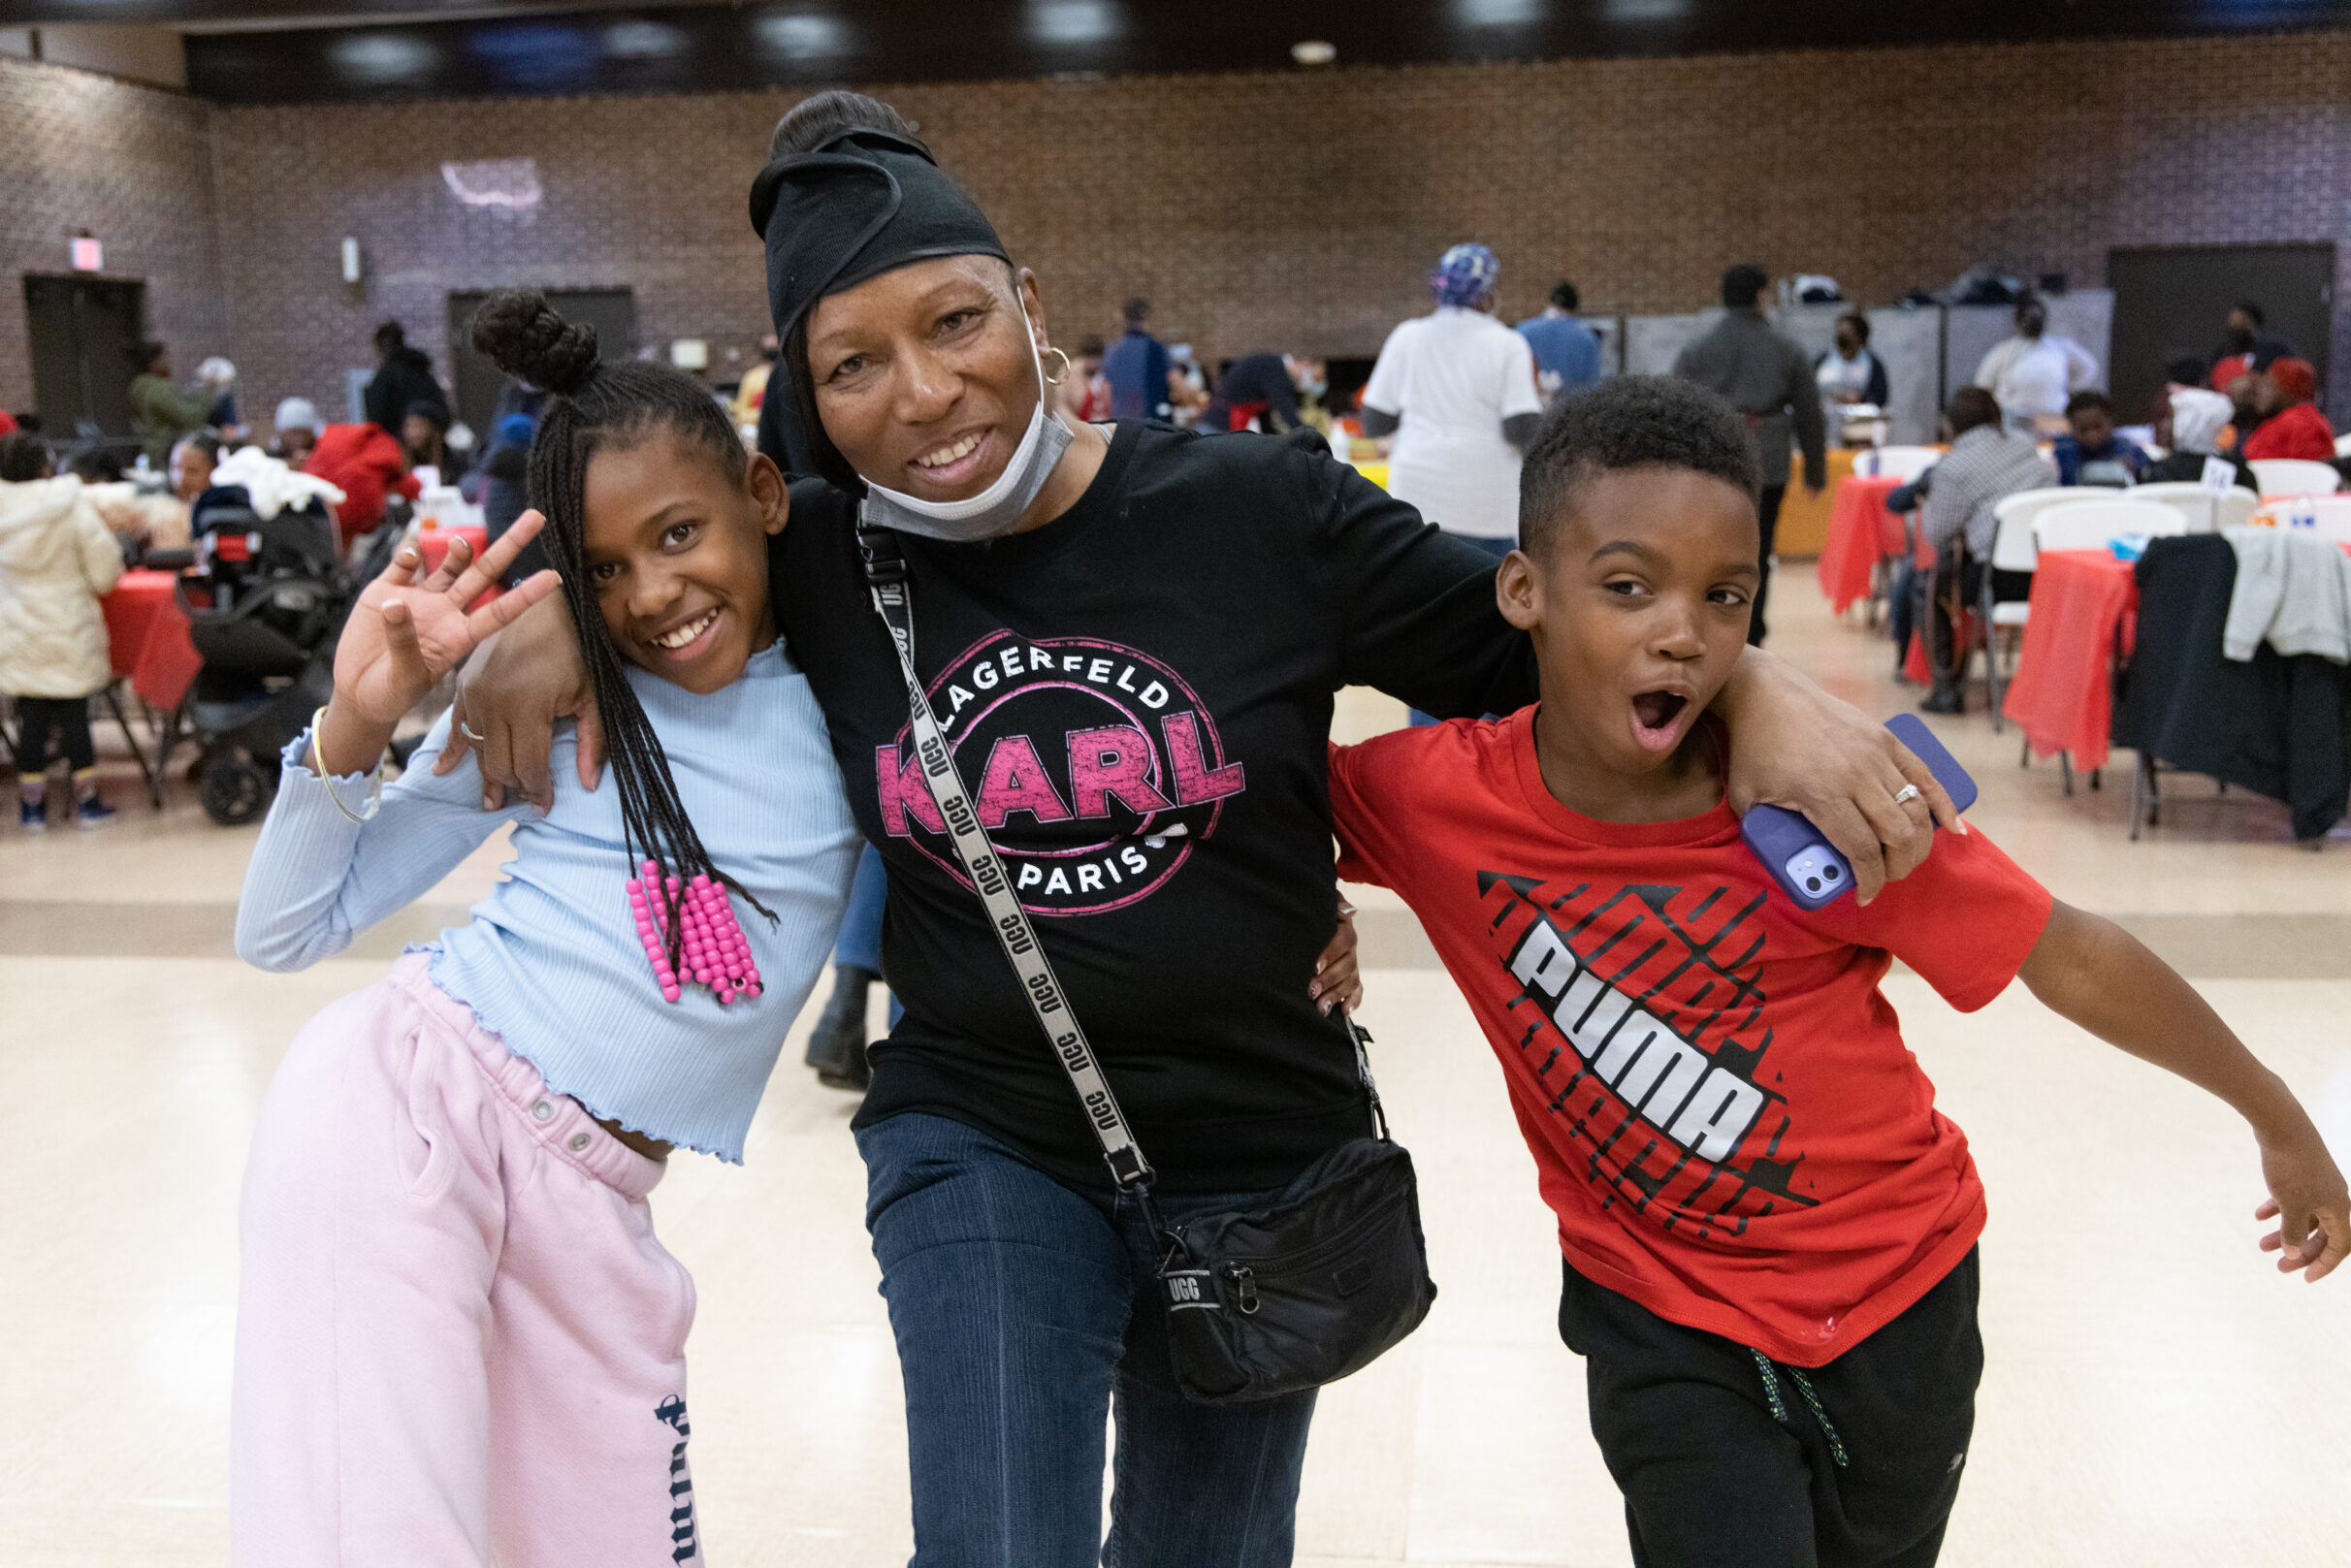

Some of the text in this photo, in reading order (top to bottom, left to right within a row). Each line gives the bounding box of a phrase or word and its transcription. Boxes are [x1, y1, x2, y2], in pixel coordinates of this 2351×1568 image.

[937, 646, 1170, 734] LAGERFELD
[875, 710, 1246, 838] KARL
[1016, 846, 1148, 896] PARIS
[1509, 919, 1764, 1164] PUMA
[1168, 1276, 1201, 1301] UGG
